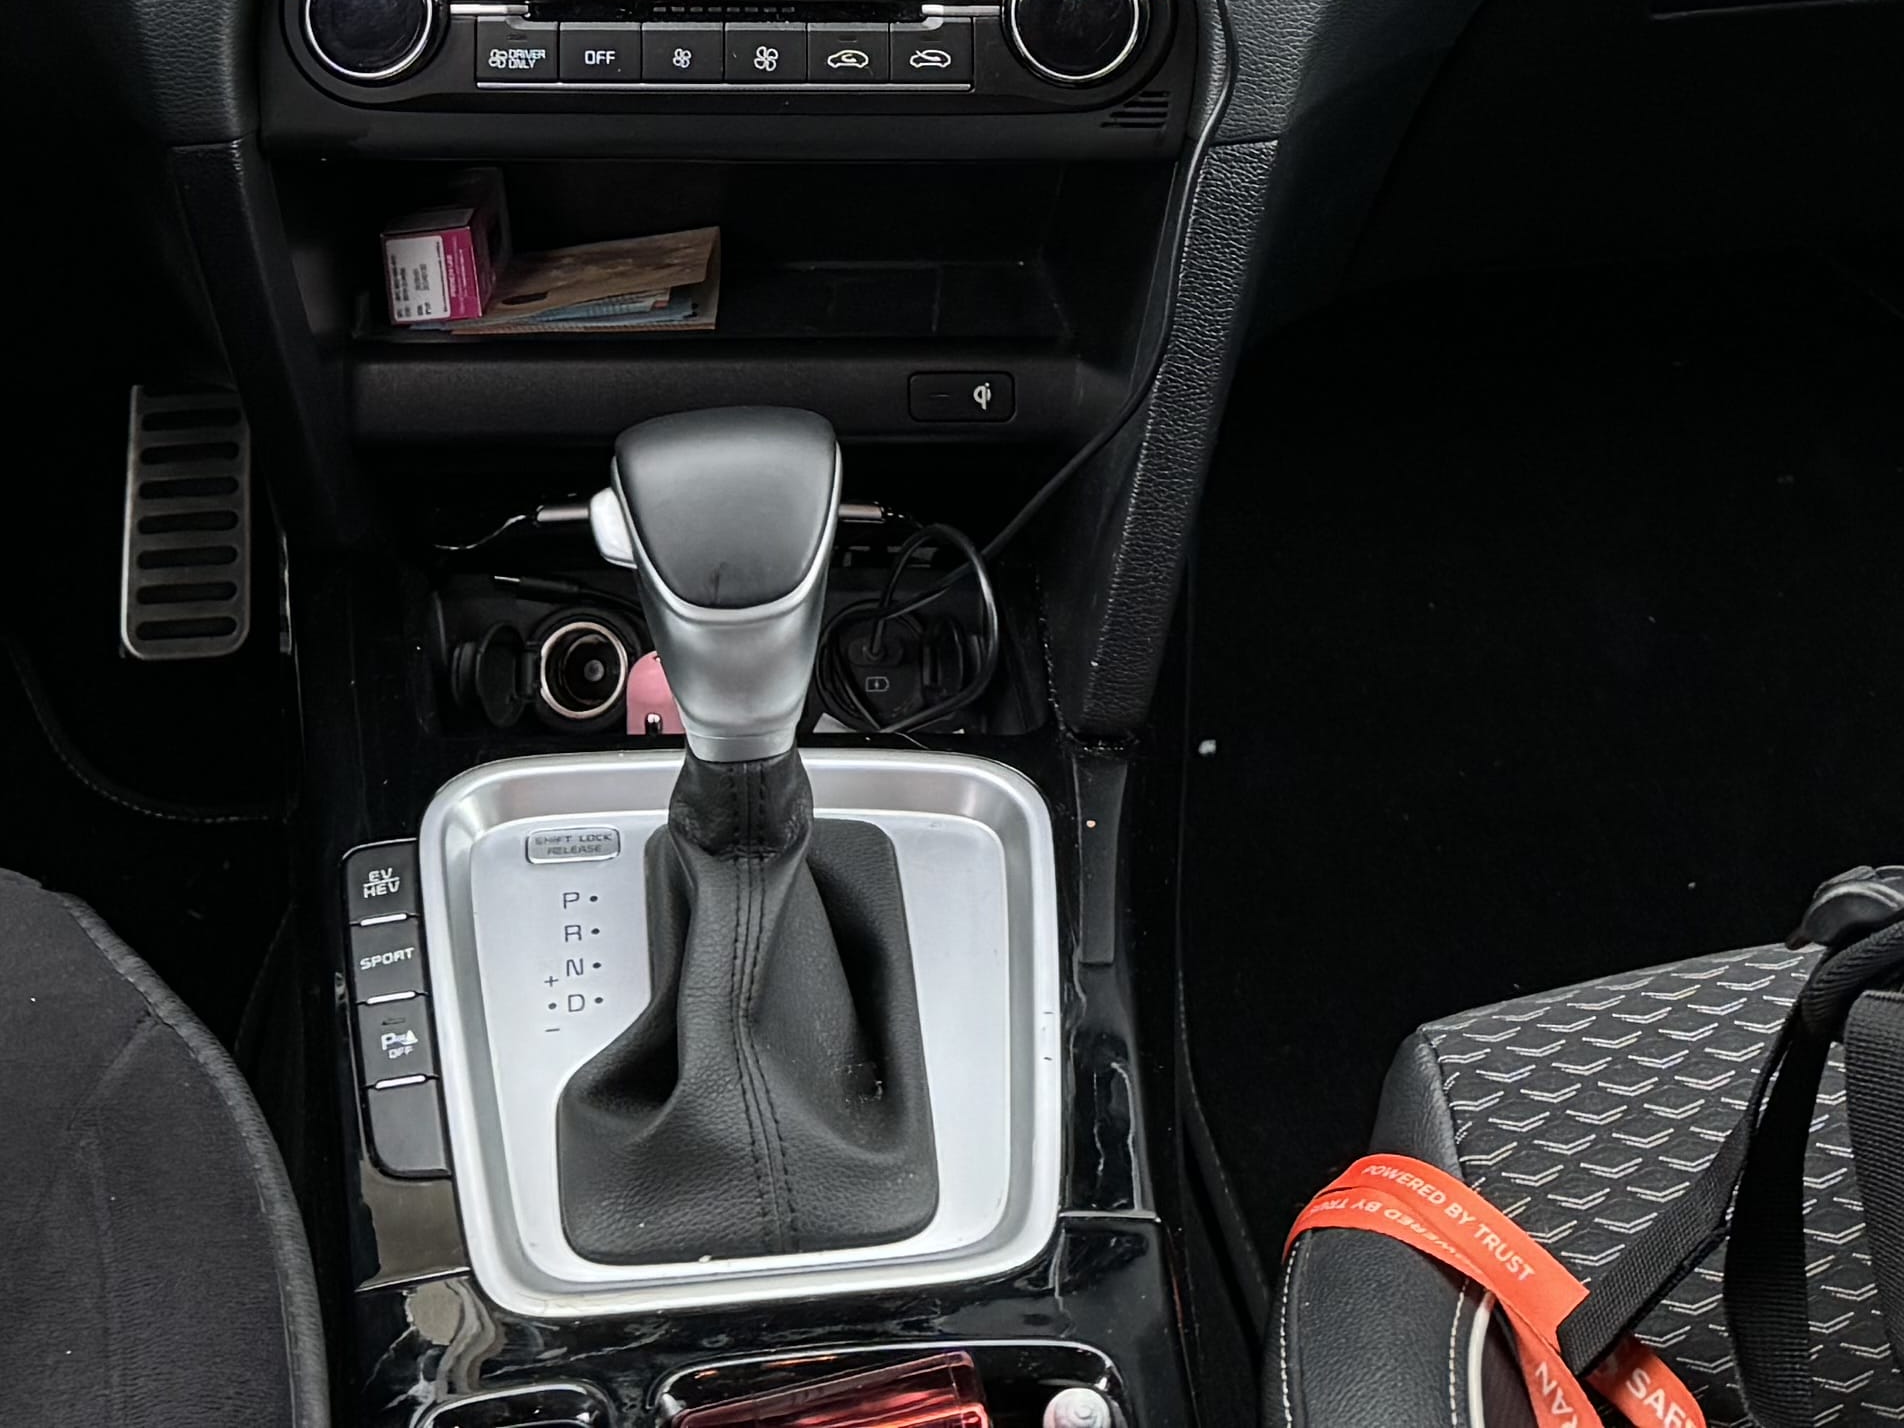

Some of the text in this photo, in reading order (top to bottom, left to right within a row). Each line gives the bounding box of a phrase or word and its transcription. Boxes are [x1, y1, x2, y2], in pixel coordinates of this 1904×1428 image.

[508, 48, 547, 60] DRIVER
[584, 49, 616, 65] OFF
[508, 58, 537, 70] ONLY
[535, 832, 614, 846] SHIFT LOCK
[546, 844, 604, 856] RELEASE
[368, 867, 394, 882] EV
[362, 880, 401, 899] HEV
[562, 891, 581, 910] P
[564, 924, 583, 943] R
[359, 946, 416, 971] SPORT
[566, 958, 585, 977] N
[567, 993, 586, 1013] D
[388, 1045, 416, 1060] OFF
[1351, 1198, 1383, 1213] BY
[1361, 1165, 1537, 1282] POWERED BY TRUST
[1625, 1367, 1696, 1428] SAF
